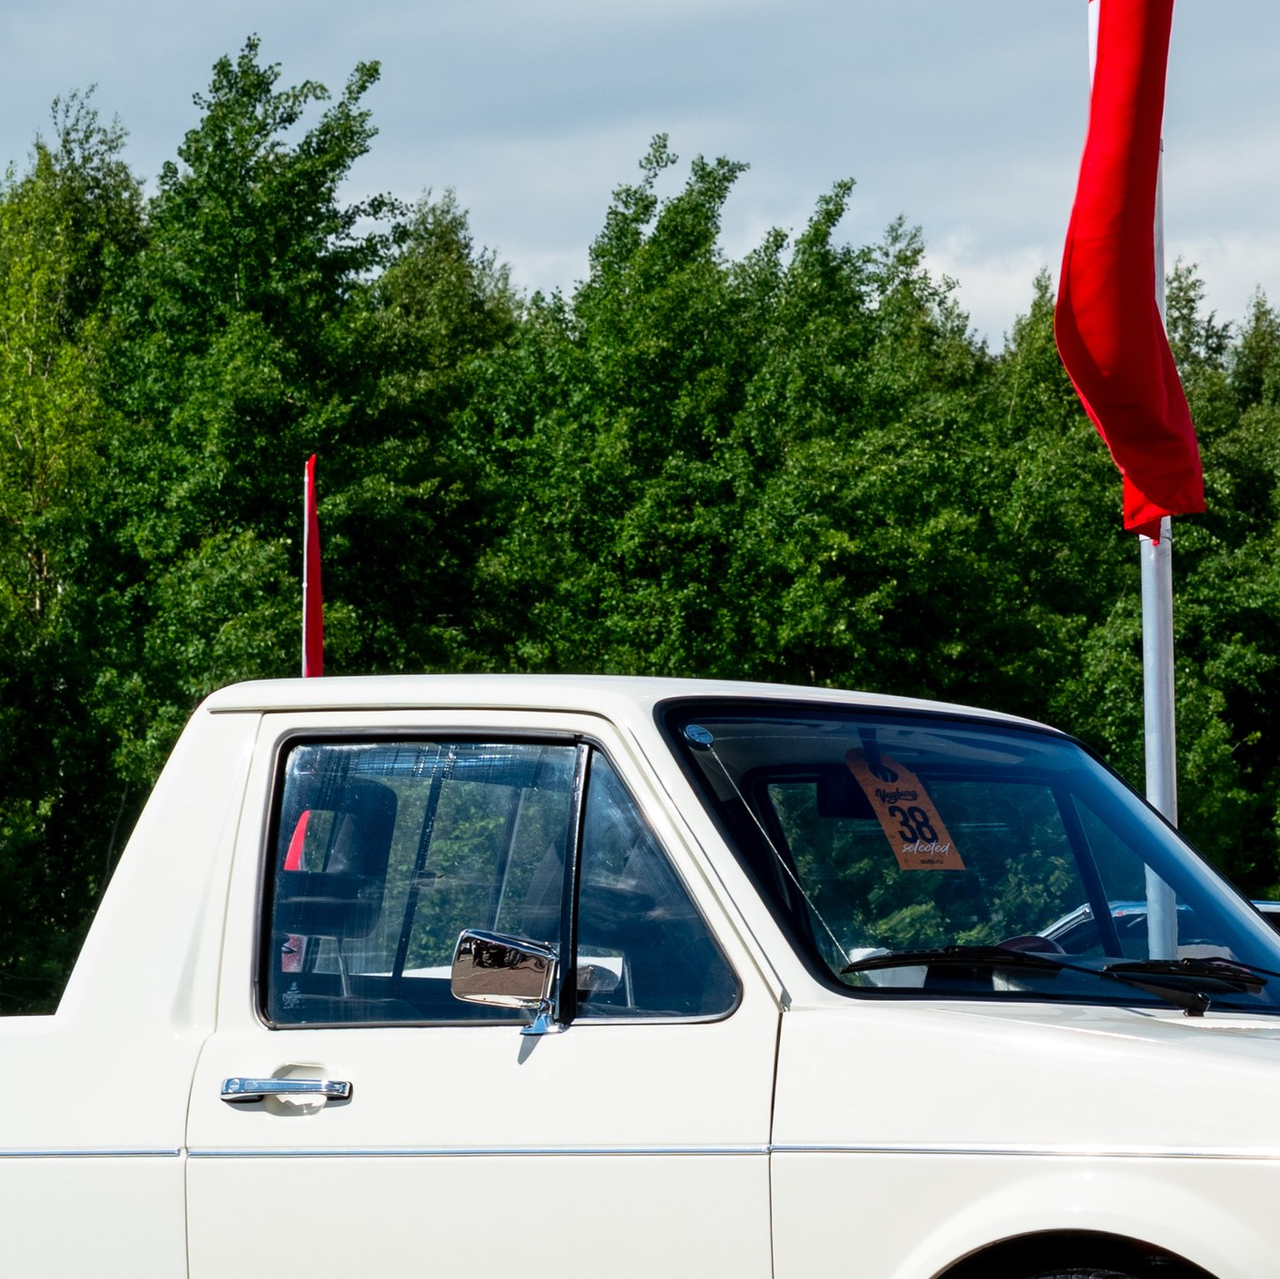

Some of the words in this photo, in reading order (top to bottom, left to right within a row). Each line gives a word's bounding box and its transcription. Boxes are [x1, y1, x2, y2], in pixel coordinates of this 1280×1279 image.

[875, 787, 920, 804] Vagburg
[888, 805, 938, 844] 38
[901, 839, 951, 856] selected
